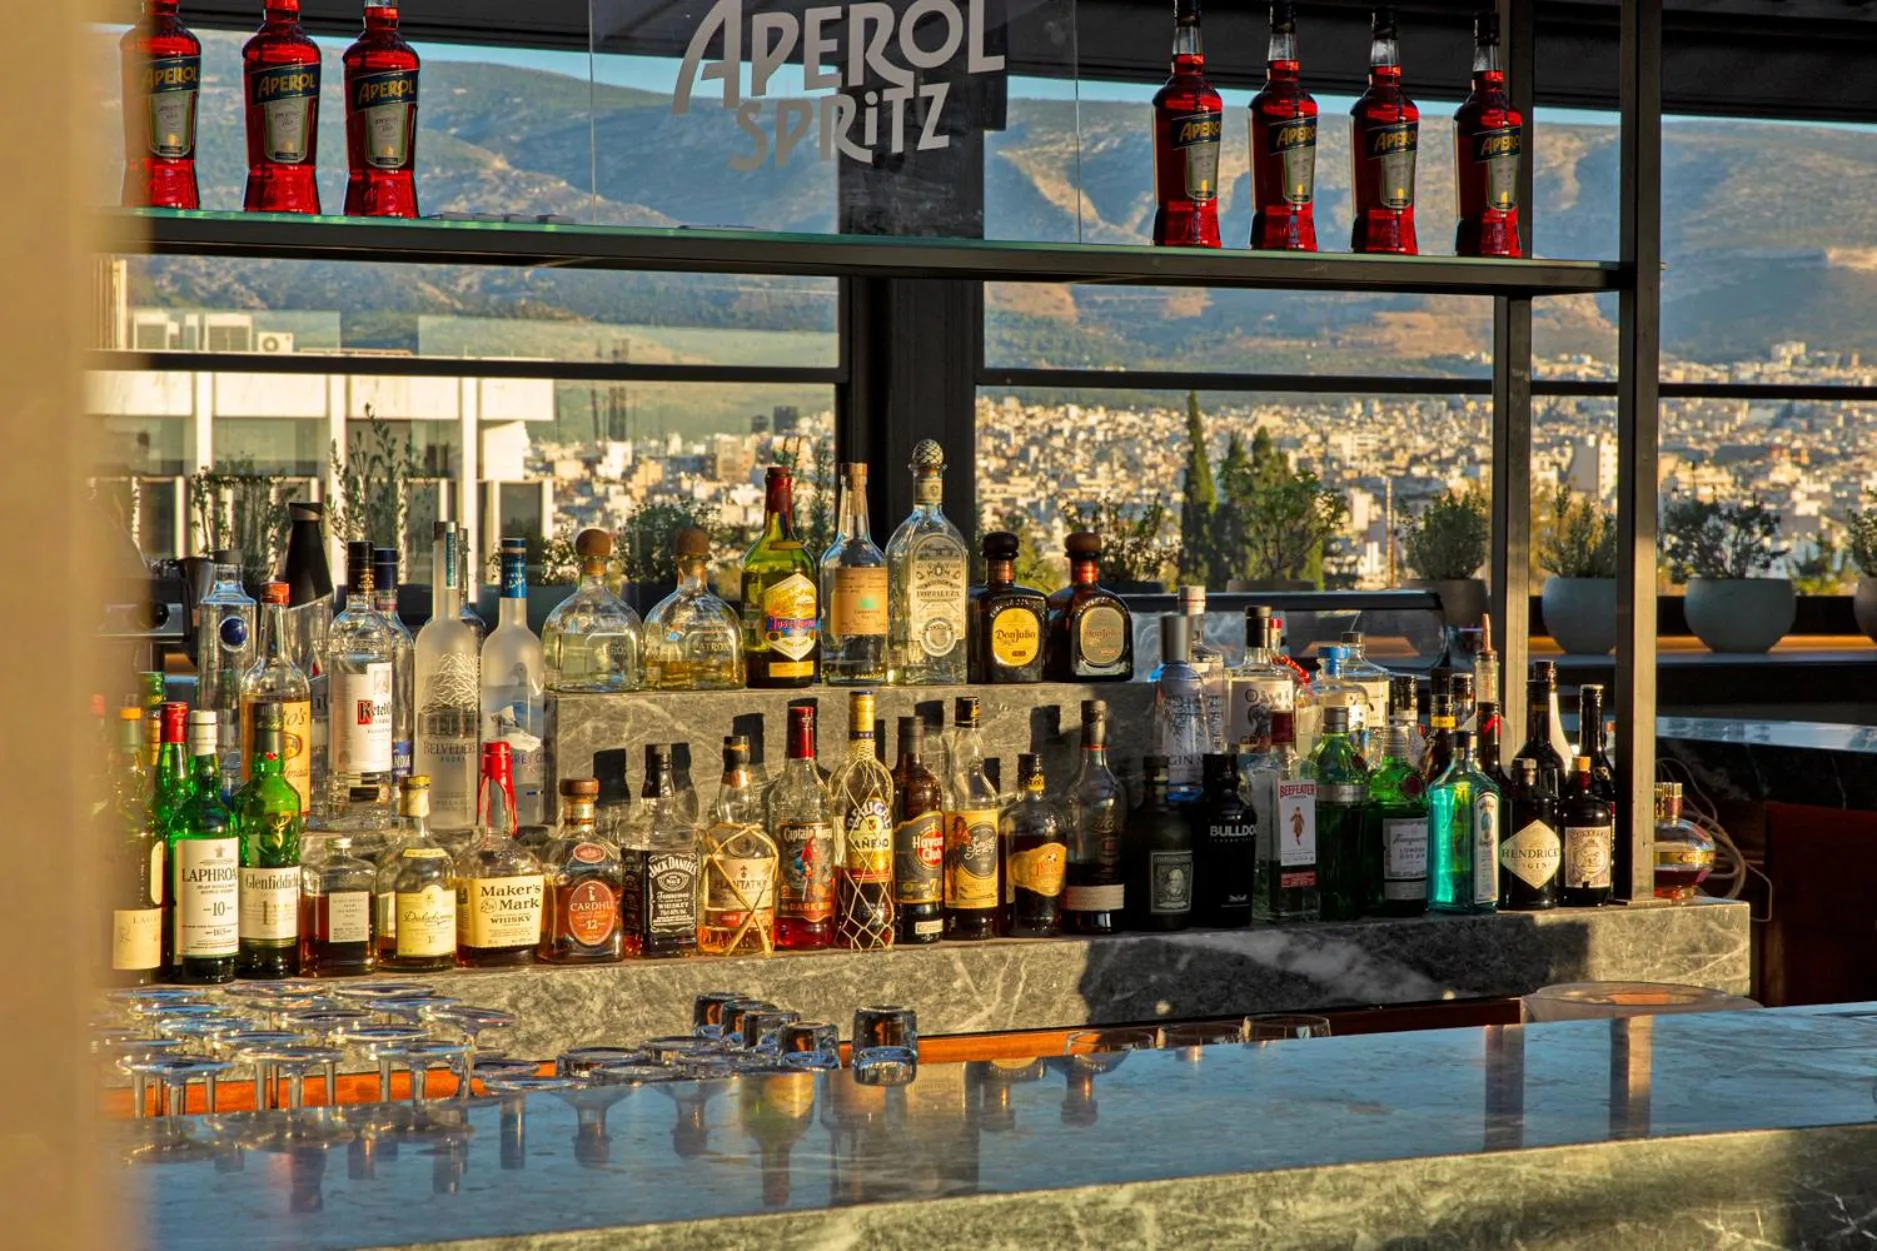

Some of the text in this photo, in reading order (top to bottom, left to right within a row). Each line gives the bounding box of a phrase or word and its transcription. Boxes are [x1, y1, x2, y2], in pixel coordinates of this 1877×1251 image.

[672, 0, 1005, 115] APEROL
[257, 73, 317, 97] APEROL
[358, 80, 415, 104] APEROL
[1279, 783, 1315, 798] BEEFEATER
[481, 883, 541, 897] Maker's
[212, 901, 225, 917] 10
[499, 897, 540, 911] Mark
[489, 914, 533, 925] WHISKY
